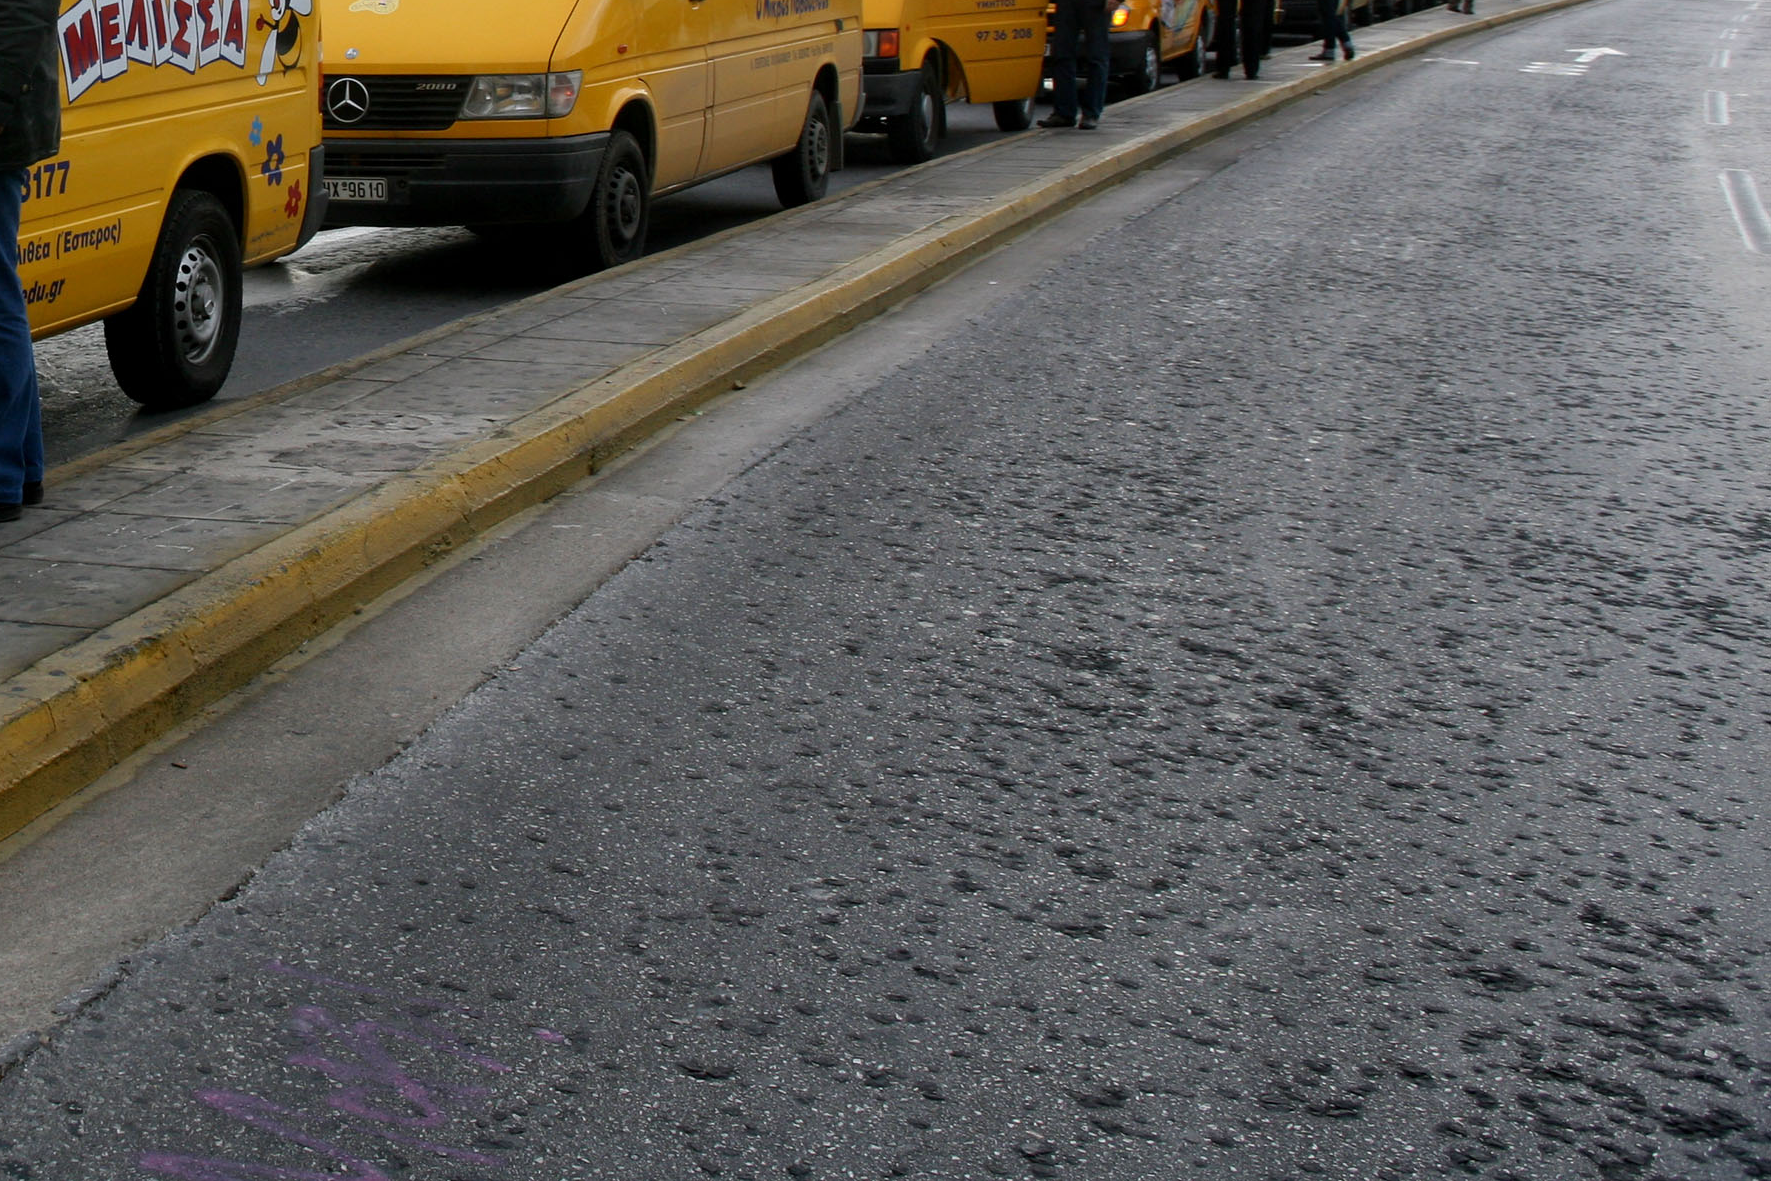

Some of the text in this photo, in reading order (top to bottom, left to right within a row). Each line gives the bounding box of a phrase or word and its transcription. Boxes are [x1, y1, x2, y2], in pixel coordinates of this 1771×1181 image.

[976, 27, 1033, 43] 97 36 208
